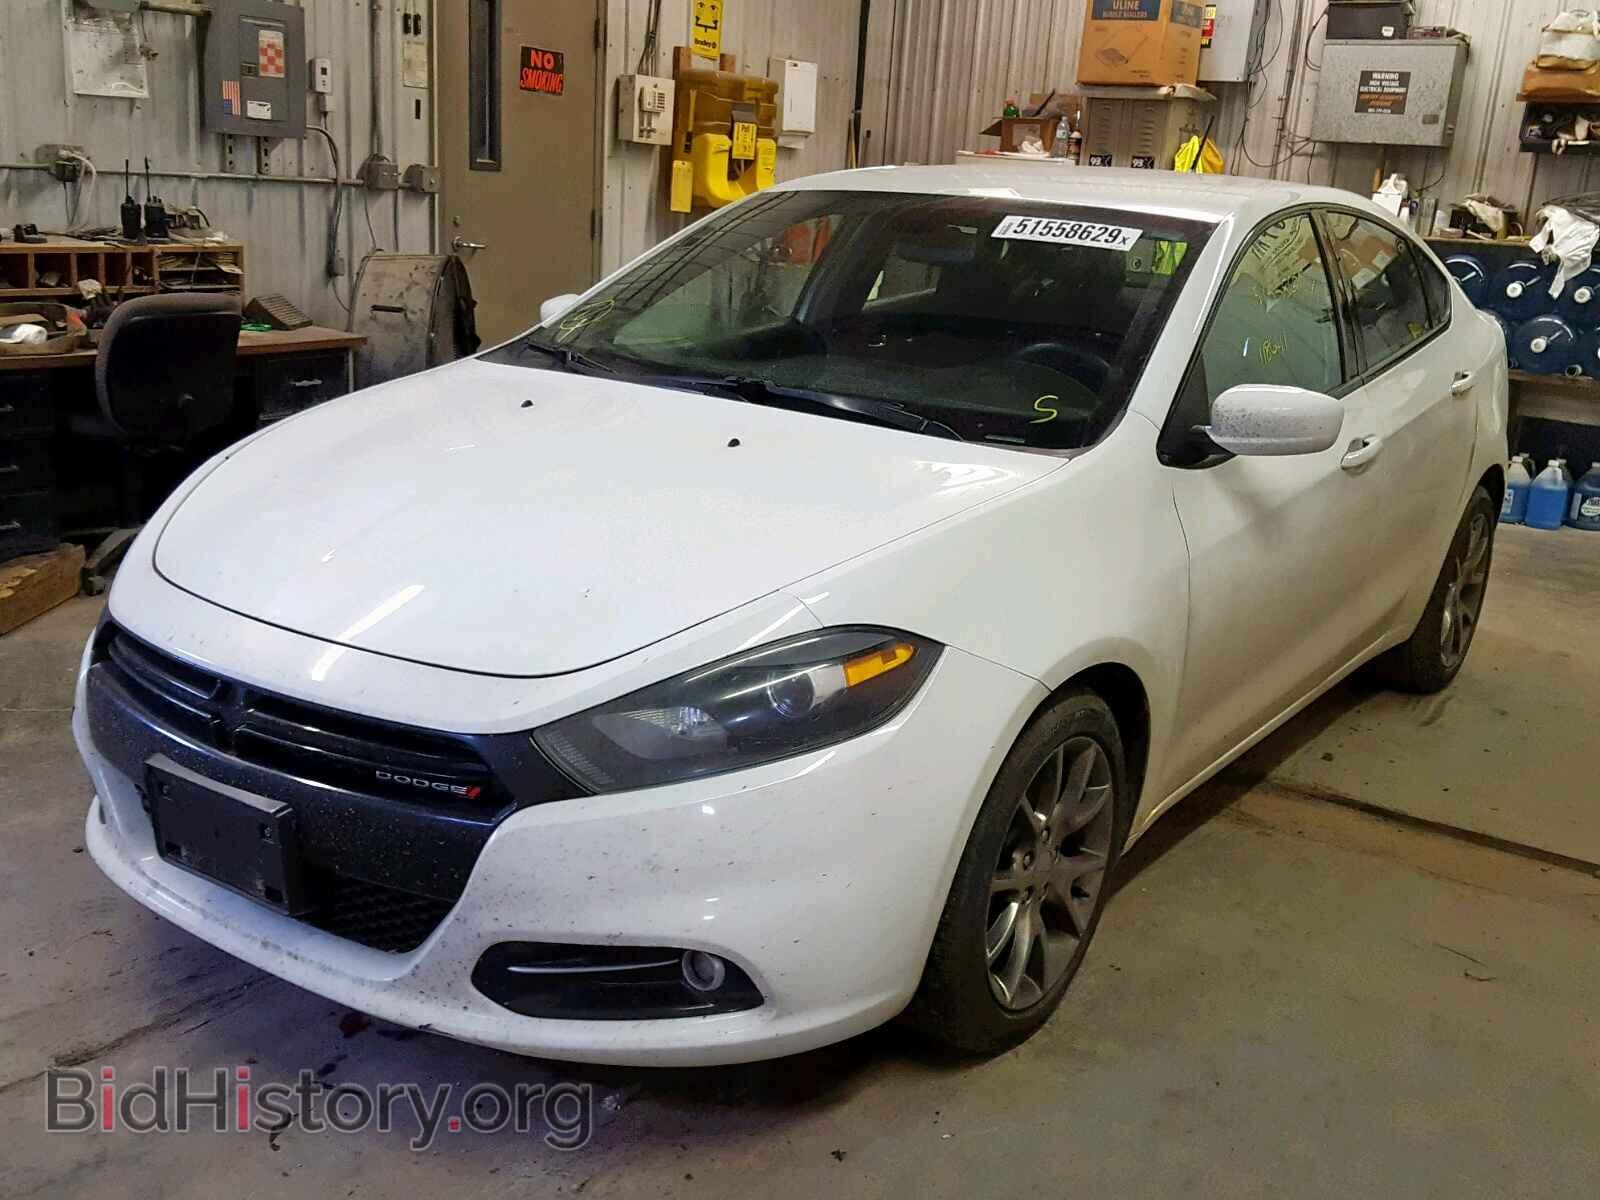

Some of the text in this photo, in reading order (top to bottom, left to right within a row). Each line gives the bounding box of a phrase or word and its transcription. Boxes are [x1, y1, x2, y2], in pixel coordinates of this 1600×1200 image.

[530, 49, 555, 69] NO
[520, 67, 563, 93] SMOKING
[375, 770, 468, 796] DODGE
